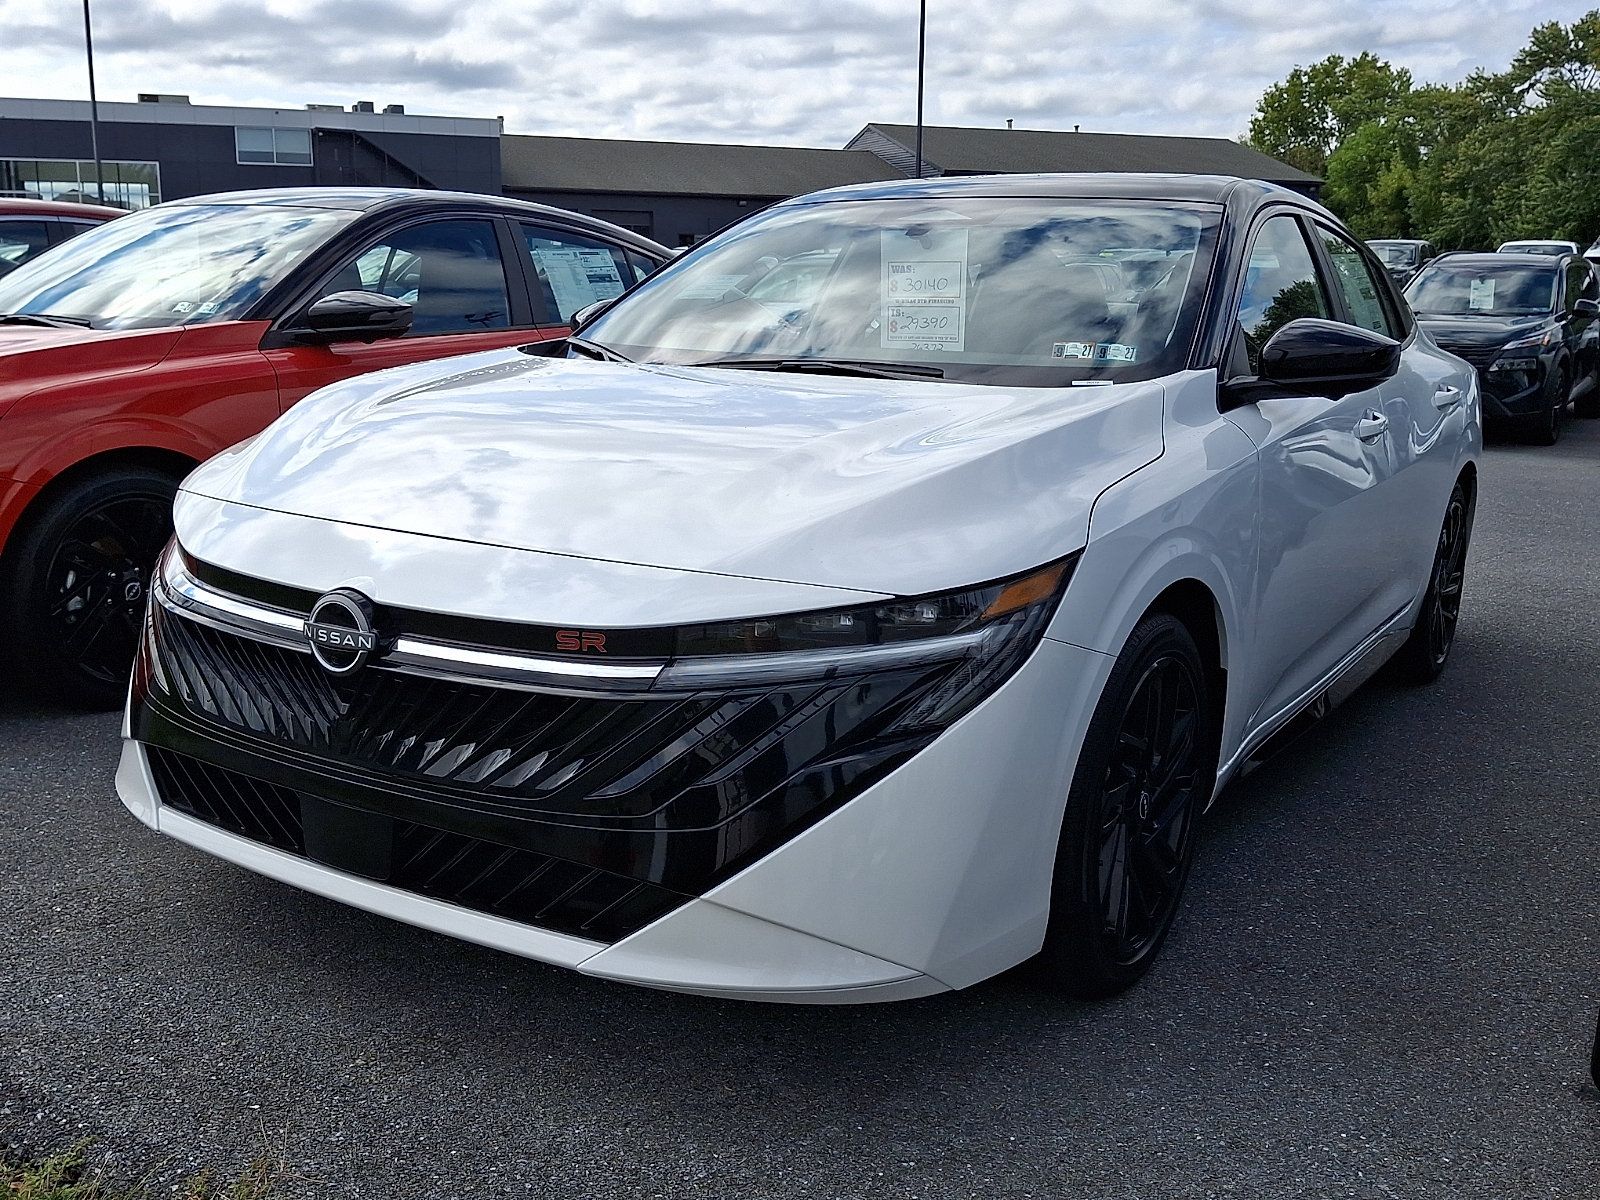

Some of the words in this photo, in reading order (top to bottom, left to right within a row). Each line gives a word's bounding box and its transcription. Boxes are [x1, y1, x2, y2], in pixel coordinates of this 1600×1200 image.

[891, 265, 915, 274] WAS:
[903, 278, 948, 292] 30140
[891, 309, 905, 317] IS:
[900, 316, 948, 330] 29390
[1081, 345, 1092, 357] 27
[1124, 347, 1135, 359] 27
[304, 624, 372, 649] NISSAN
[556, 630, 607, 653] SR
